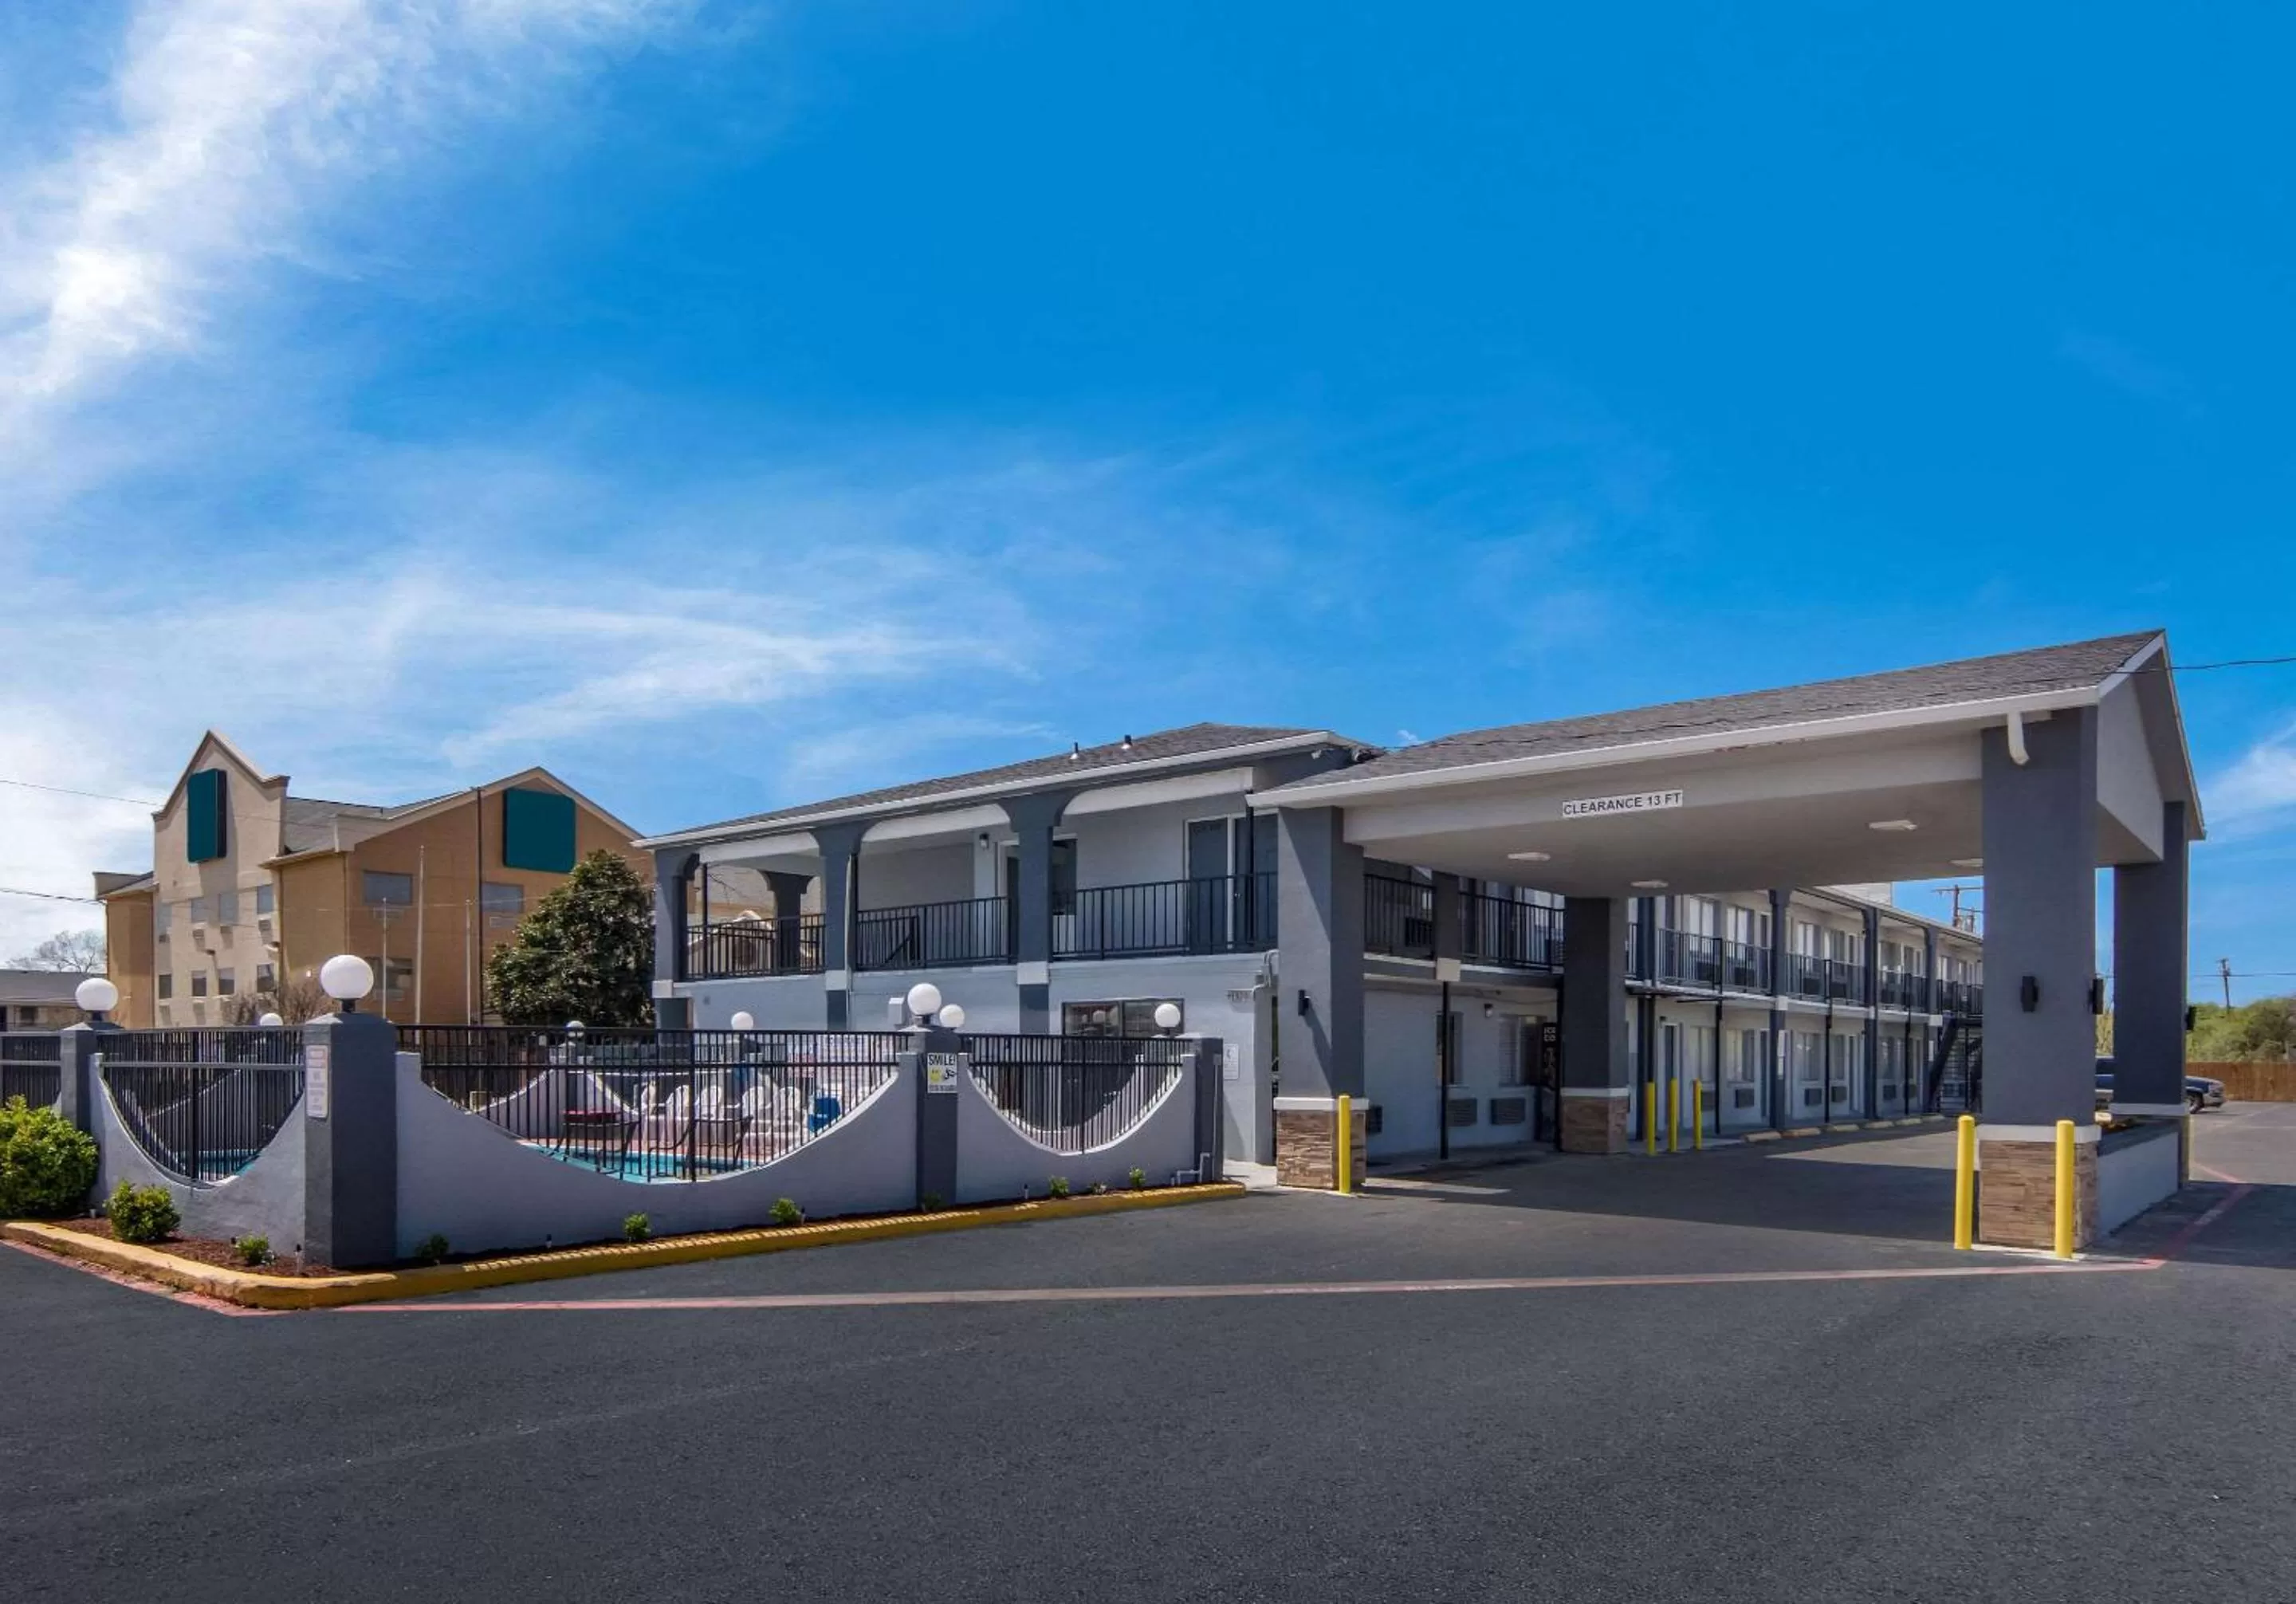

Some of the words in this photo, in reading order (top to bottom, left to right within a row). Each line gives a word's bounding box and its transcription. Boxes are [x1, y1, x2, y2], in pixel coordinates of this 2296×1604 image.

[1563, 796, 1643, 815] CLEARANCE
[1648, 795, 1661, 807] 13
[1665, 792, 1681, 804] FT
